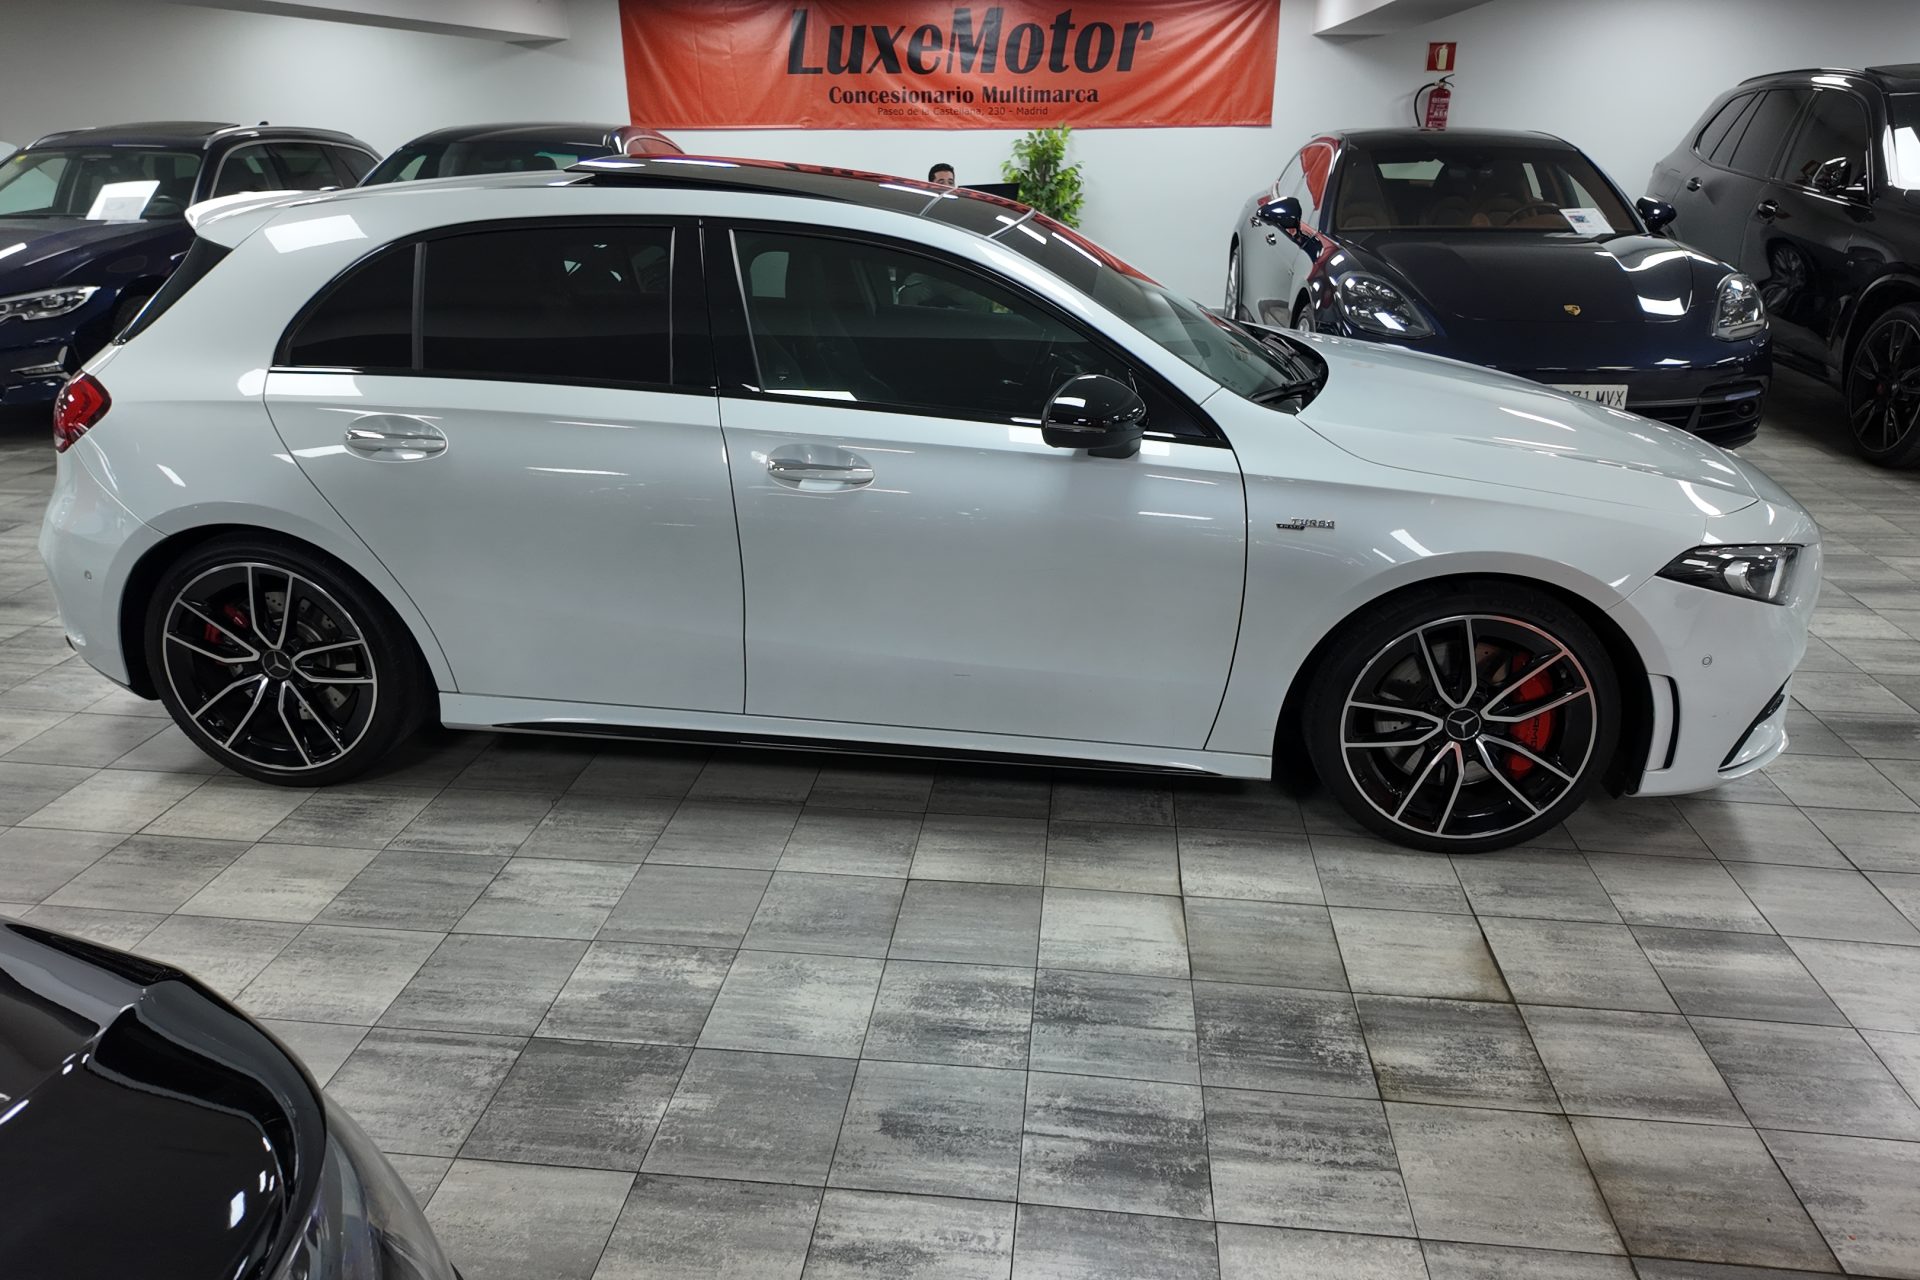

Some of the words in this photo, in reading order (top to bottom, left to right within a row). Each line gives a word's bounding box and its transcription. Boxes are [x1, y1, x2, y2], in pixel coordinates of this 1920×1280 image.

[787, 7, 1154, 75] LuxeMotor
[828, 86, 974, 104] Concesionario
[982, 85, 1099, 103] Multimarca
[877, 107, 904, 116] Paseo
[907, 107, 919, 116] de
[921, 107, 930, 116] la
[934, 107, 985, 117] Castellana,
[988, 106, 1006, 116] 230
[1016, 106, 1048, 116] Madrid
[1595, 390, 1625, 406] MVX
[1291, 517, 1336, 530] TURBO
